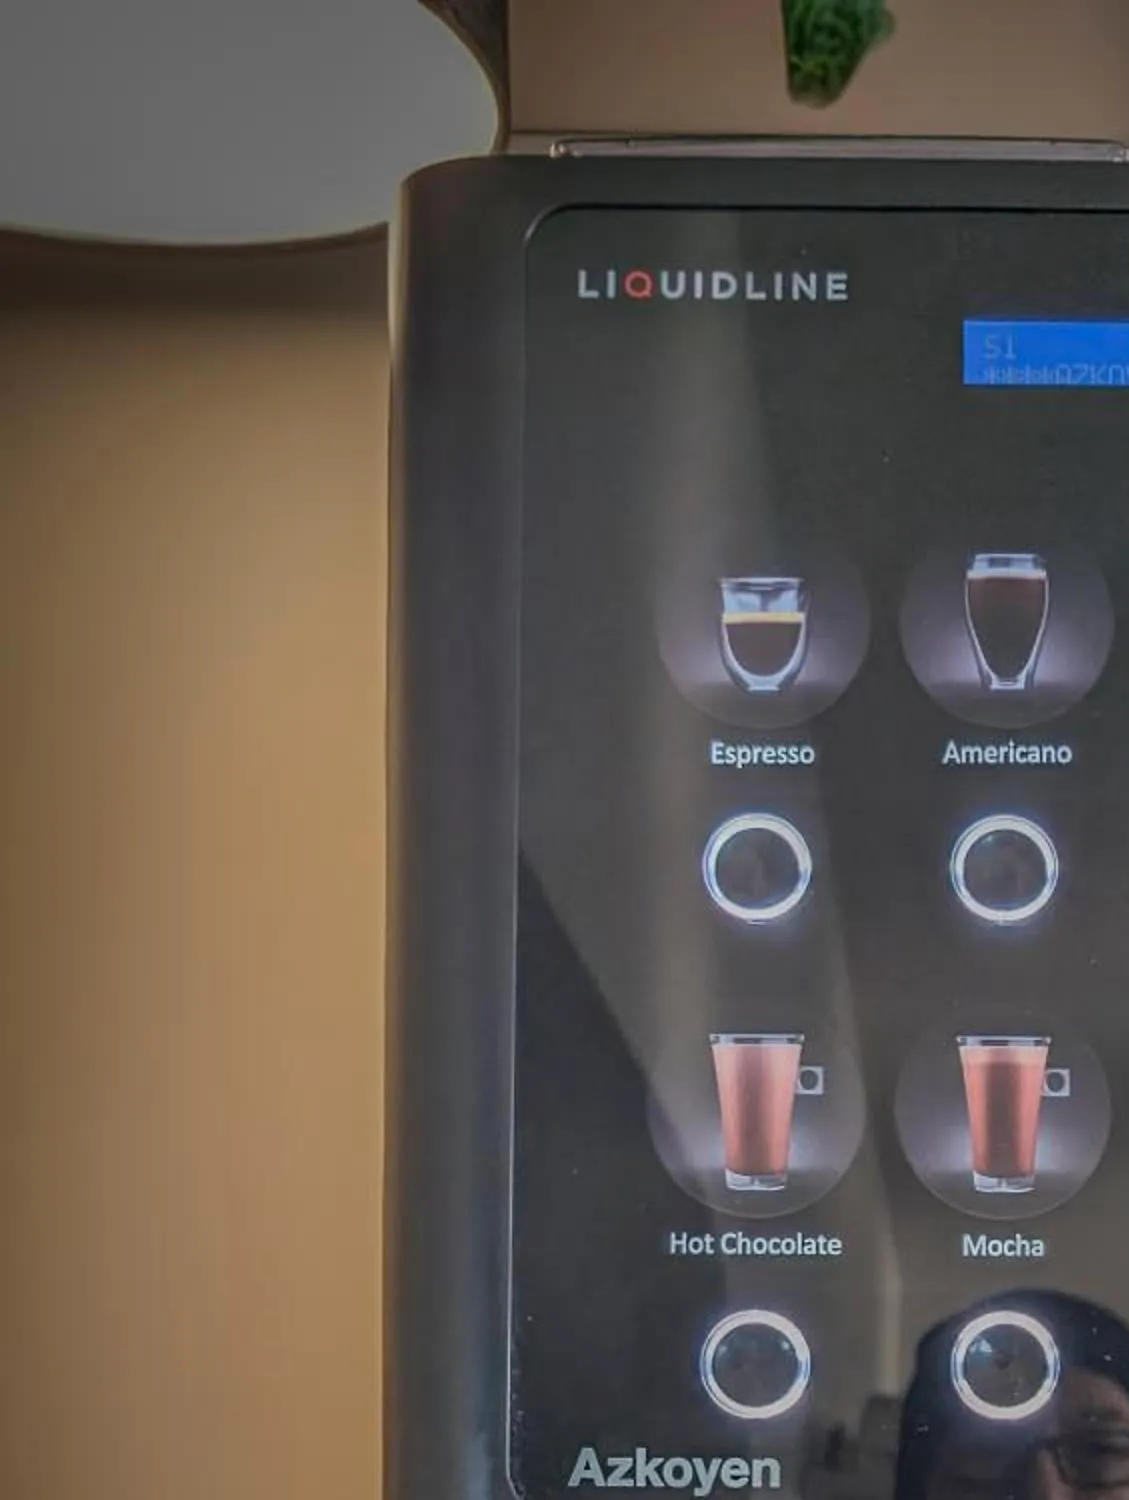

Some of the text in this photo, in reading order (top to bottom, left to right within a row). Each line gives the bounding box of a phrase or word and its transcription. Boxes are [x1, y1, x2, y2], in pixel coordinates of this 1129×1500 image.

[577, 269, 848, 301] LIQUIDLINE
[710, 741, 815, 768] Espresso
[941, 740, 1073, 765] Americano
[669, 1231, 843, 1256] Hot Chocolate
[962, 1234, 1045, 1257] Mocha
[567, 1447, 781, 1497] Azkoyen
